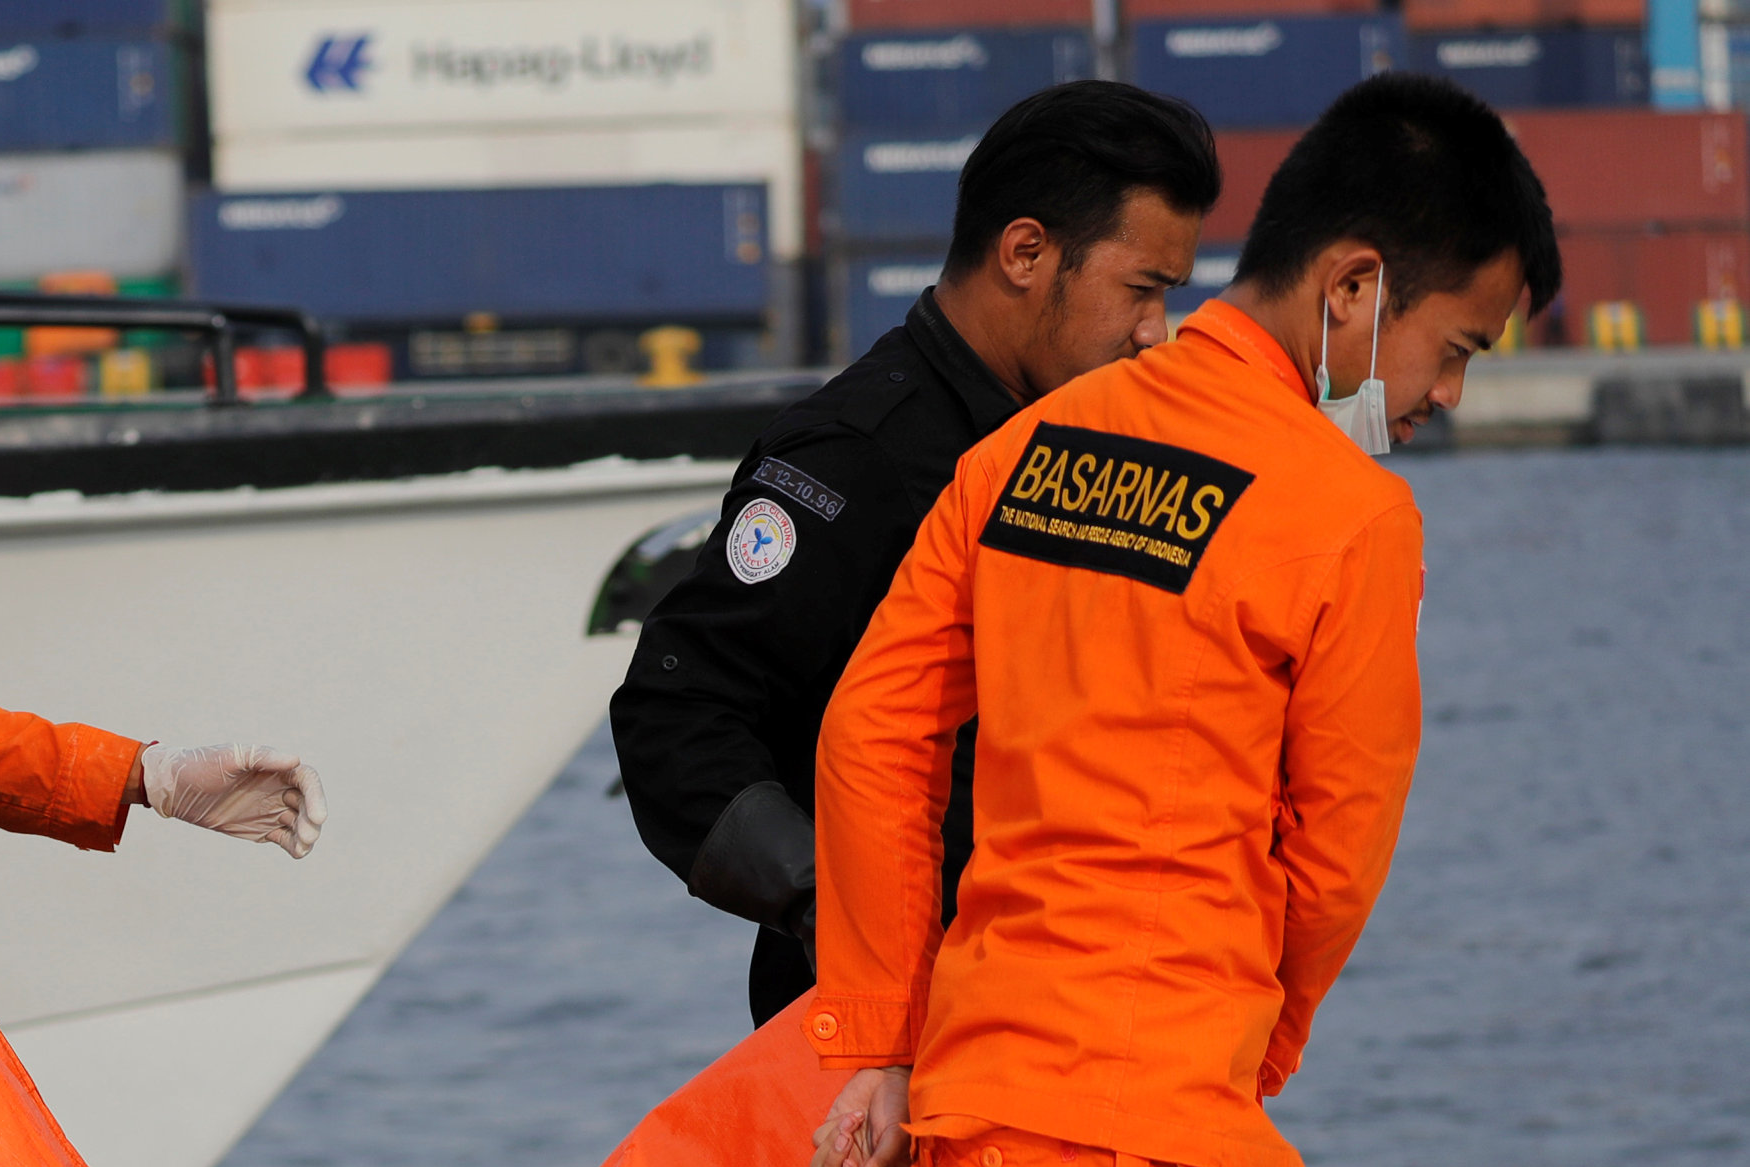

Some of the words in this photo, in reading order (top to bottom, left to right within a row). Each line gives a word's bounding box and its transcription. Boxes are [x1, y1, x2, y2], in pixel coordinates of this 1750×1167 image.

[412, 36, 712, 84] Hapag-Lloyd
[744, 505, 766, 521] KEDAI
[1011, 445, 1224, 540] BASARNAS
[999, 505, 1016, 525] THE
[1013, 509, 1048, 533] NATIONAL
[1047, 517, 1078, 539] SEARCH
[1133, 534, 1149, 551] OF
[1144, 538, 1192, 567] INDONESIA
